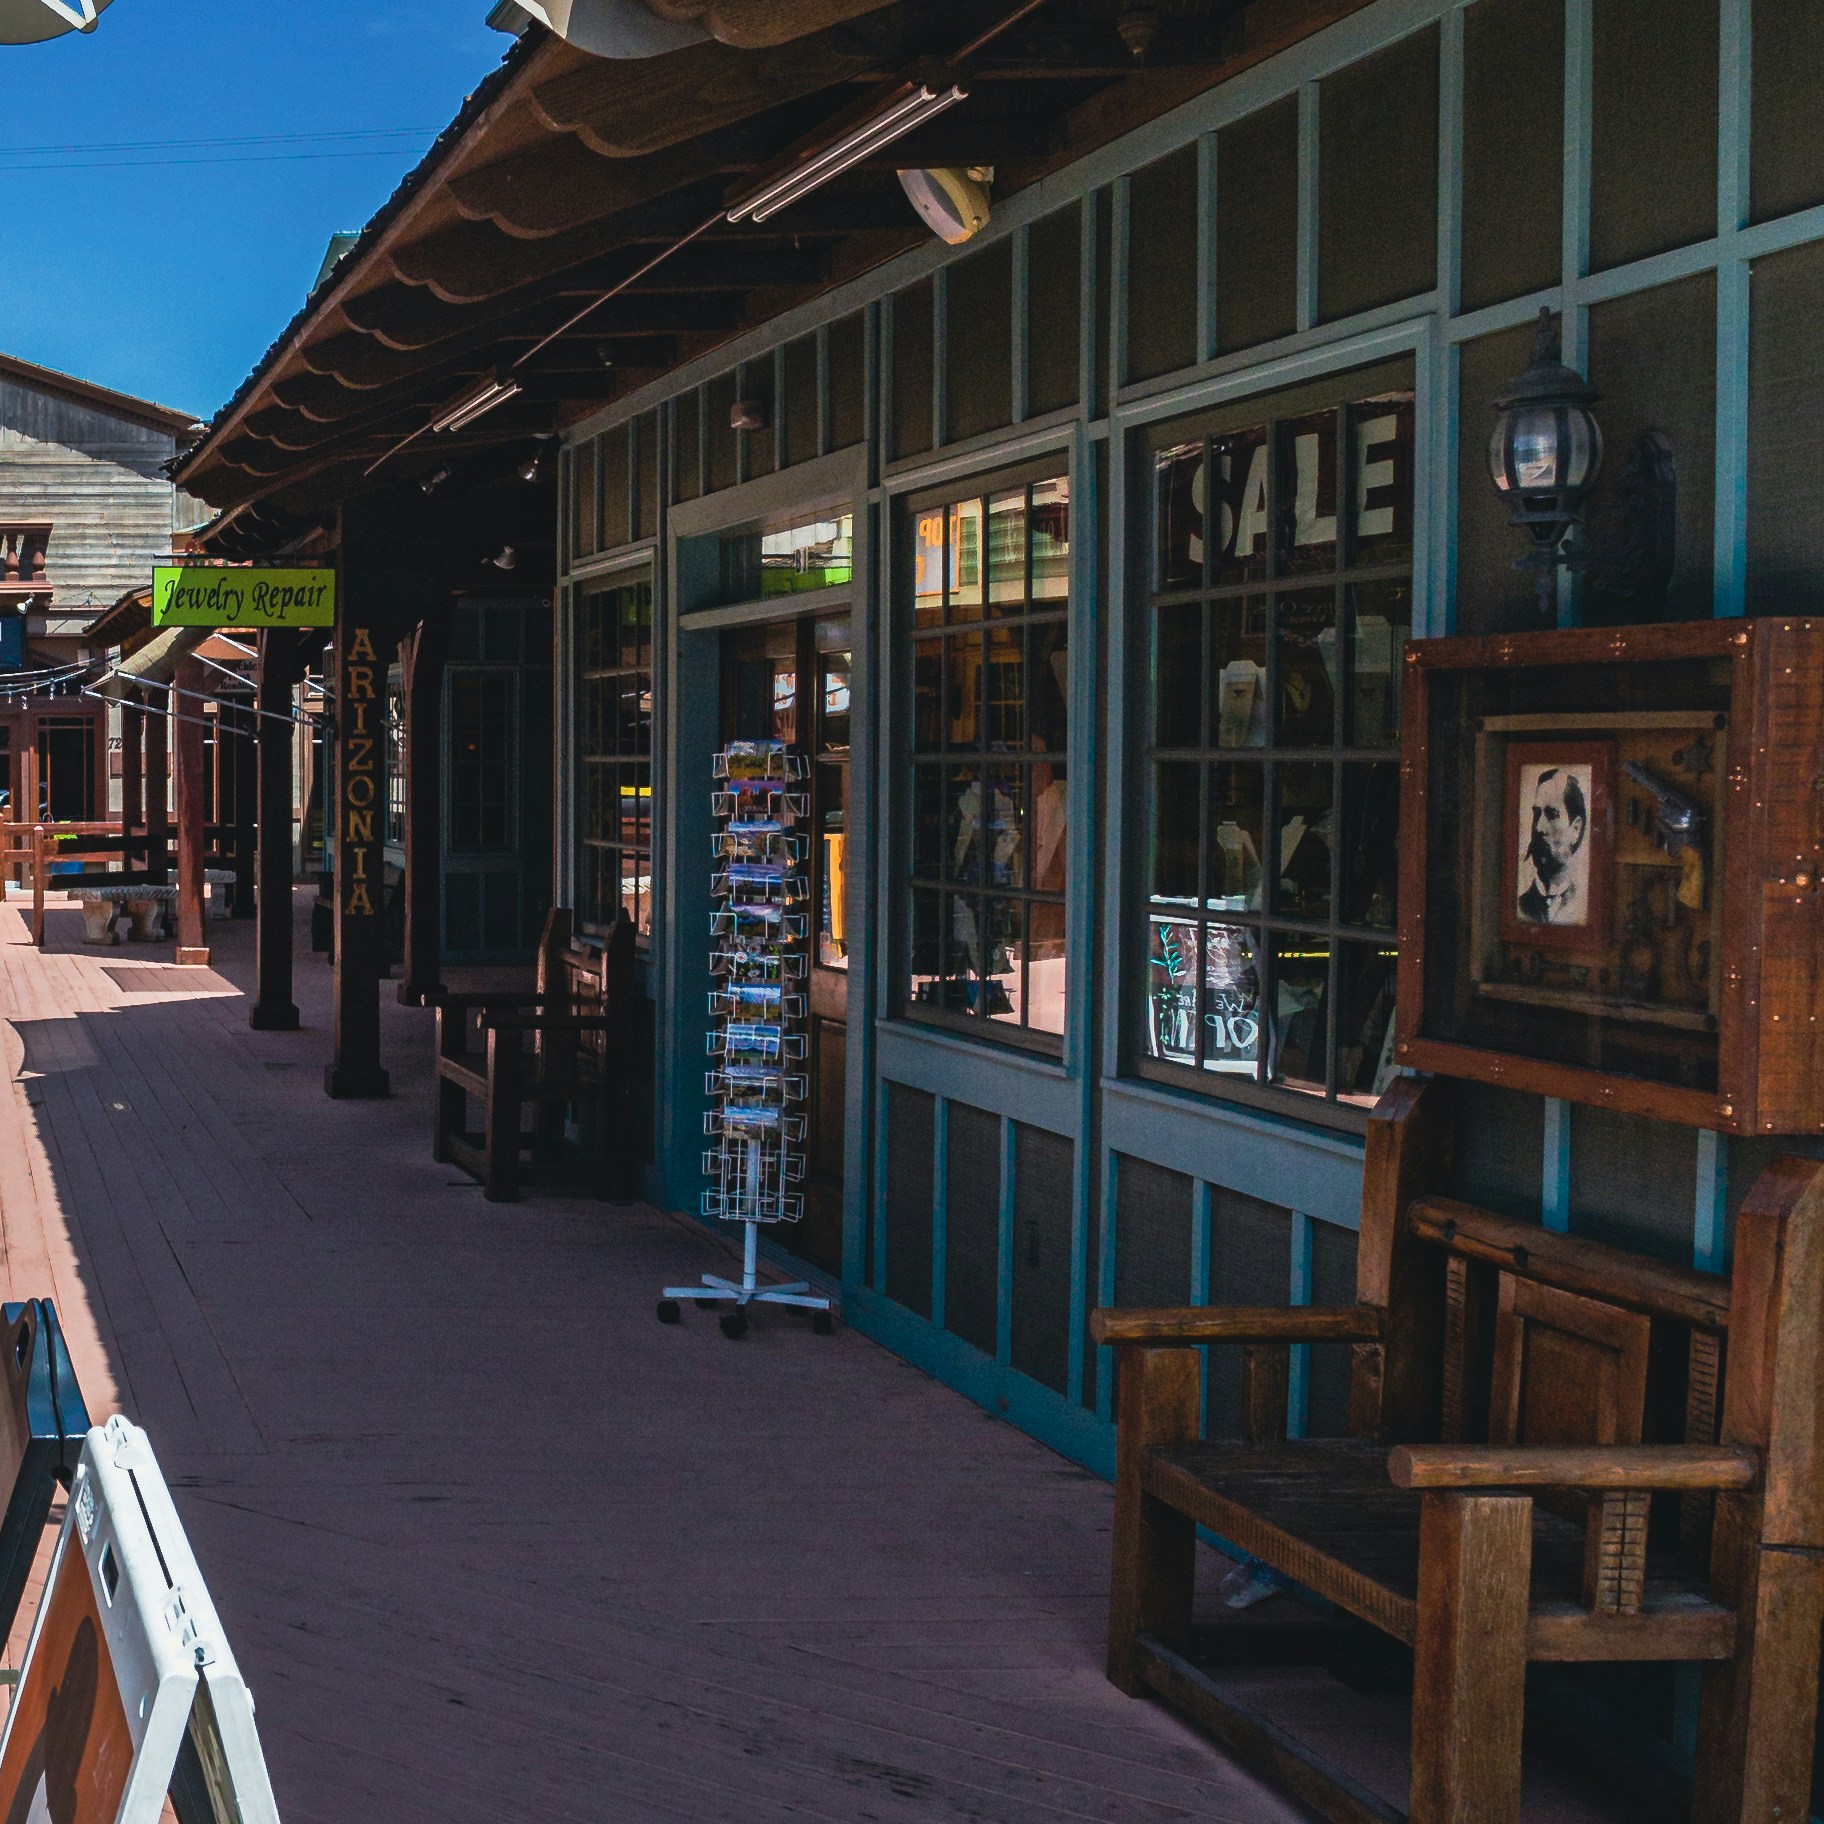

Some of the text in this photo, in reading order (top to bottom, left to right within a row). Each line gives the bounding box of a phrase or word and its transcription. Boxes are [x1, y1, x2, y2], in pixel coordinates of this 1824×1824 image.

[1189, 413, 1398, 565] SALE
[160, 575, 327, 622] Jewelry Repair
[345, 628, 377, 916] ARIZONIA
